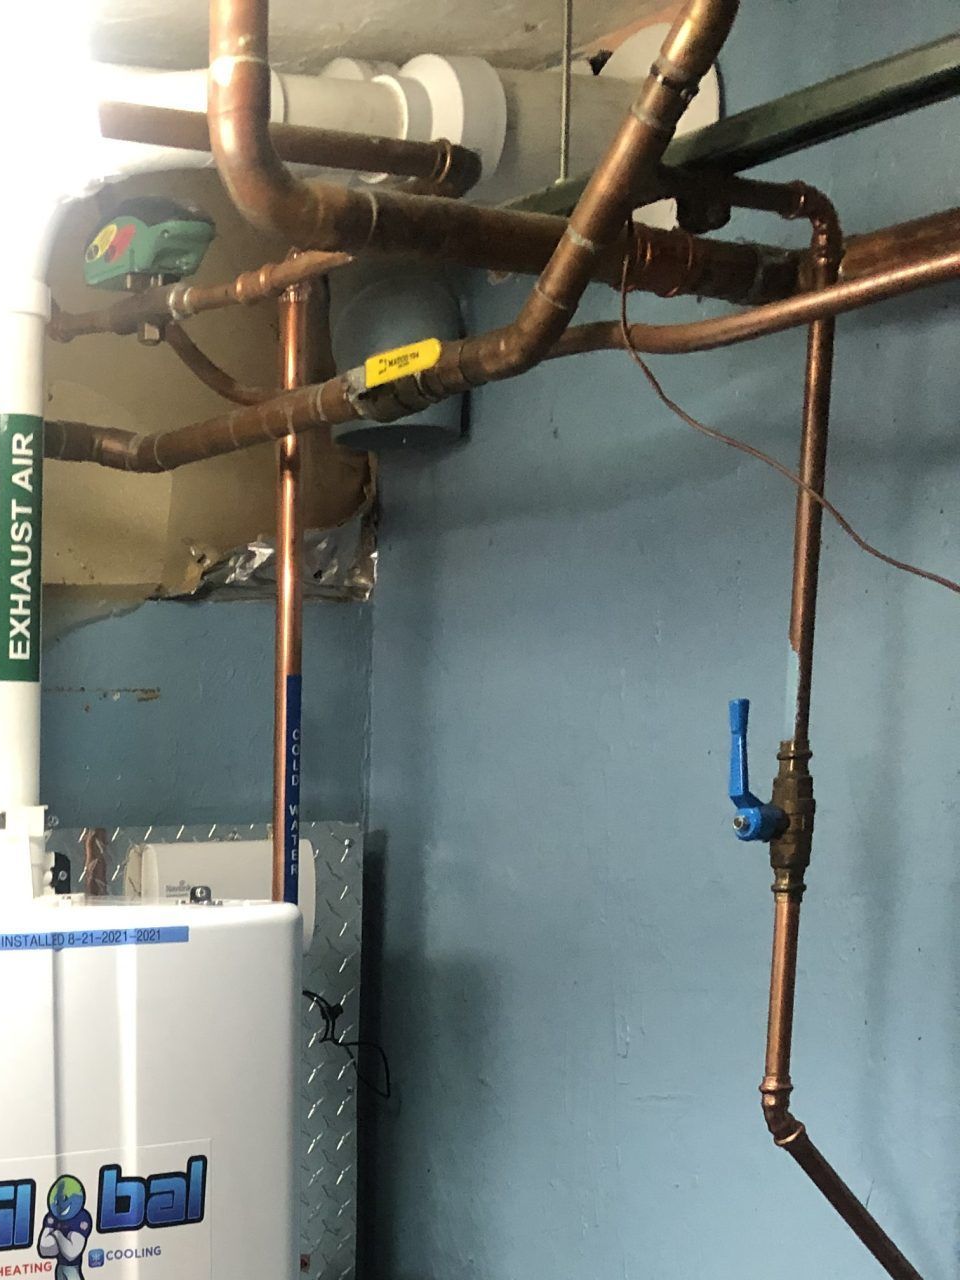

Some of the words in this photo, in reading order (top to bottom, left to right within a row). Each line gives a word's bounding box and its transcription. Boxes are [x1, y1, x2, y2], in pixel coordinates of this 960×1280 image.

[11, 432, 34, 493] AIR
[8, 498, 33, 661] EXHAUST
[290, 728, 300, 787] COLD
[288, 804, 299, 876] WATER
[1, 934, 65, 948] INSTALLED
[67, 929, 162, 946] 8-21-2021-2021
[105, 1246, 162, 1262] COOLING
